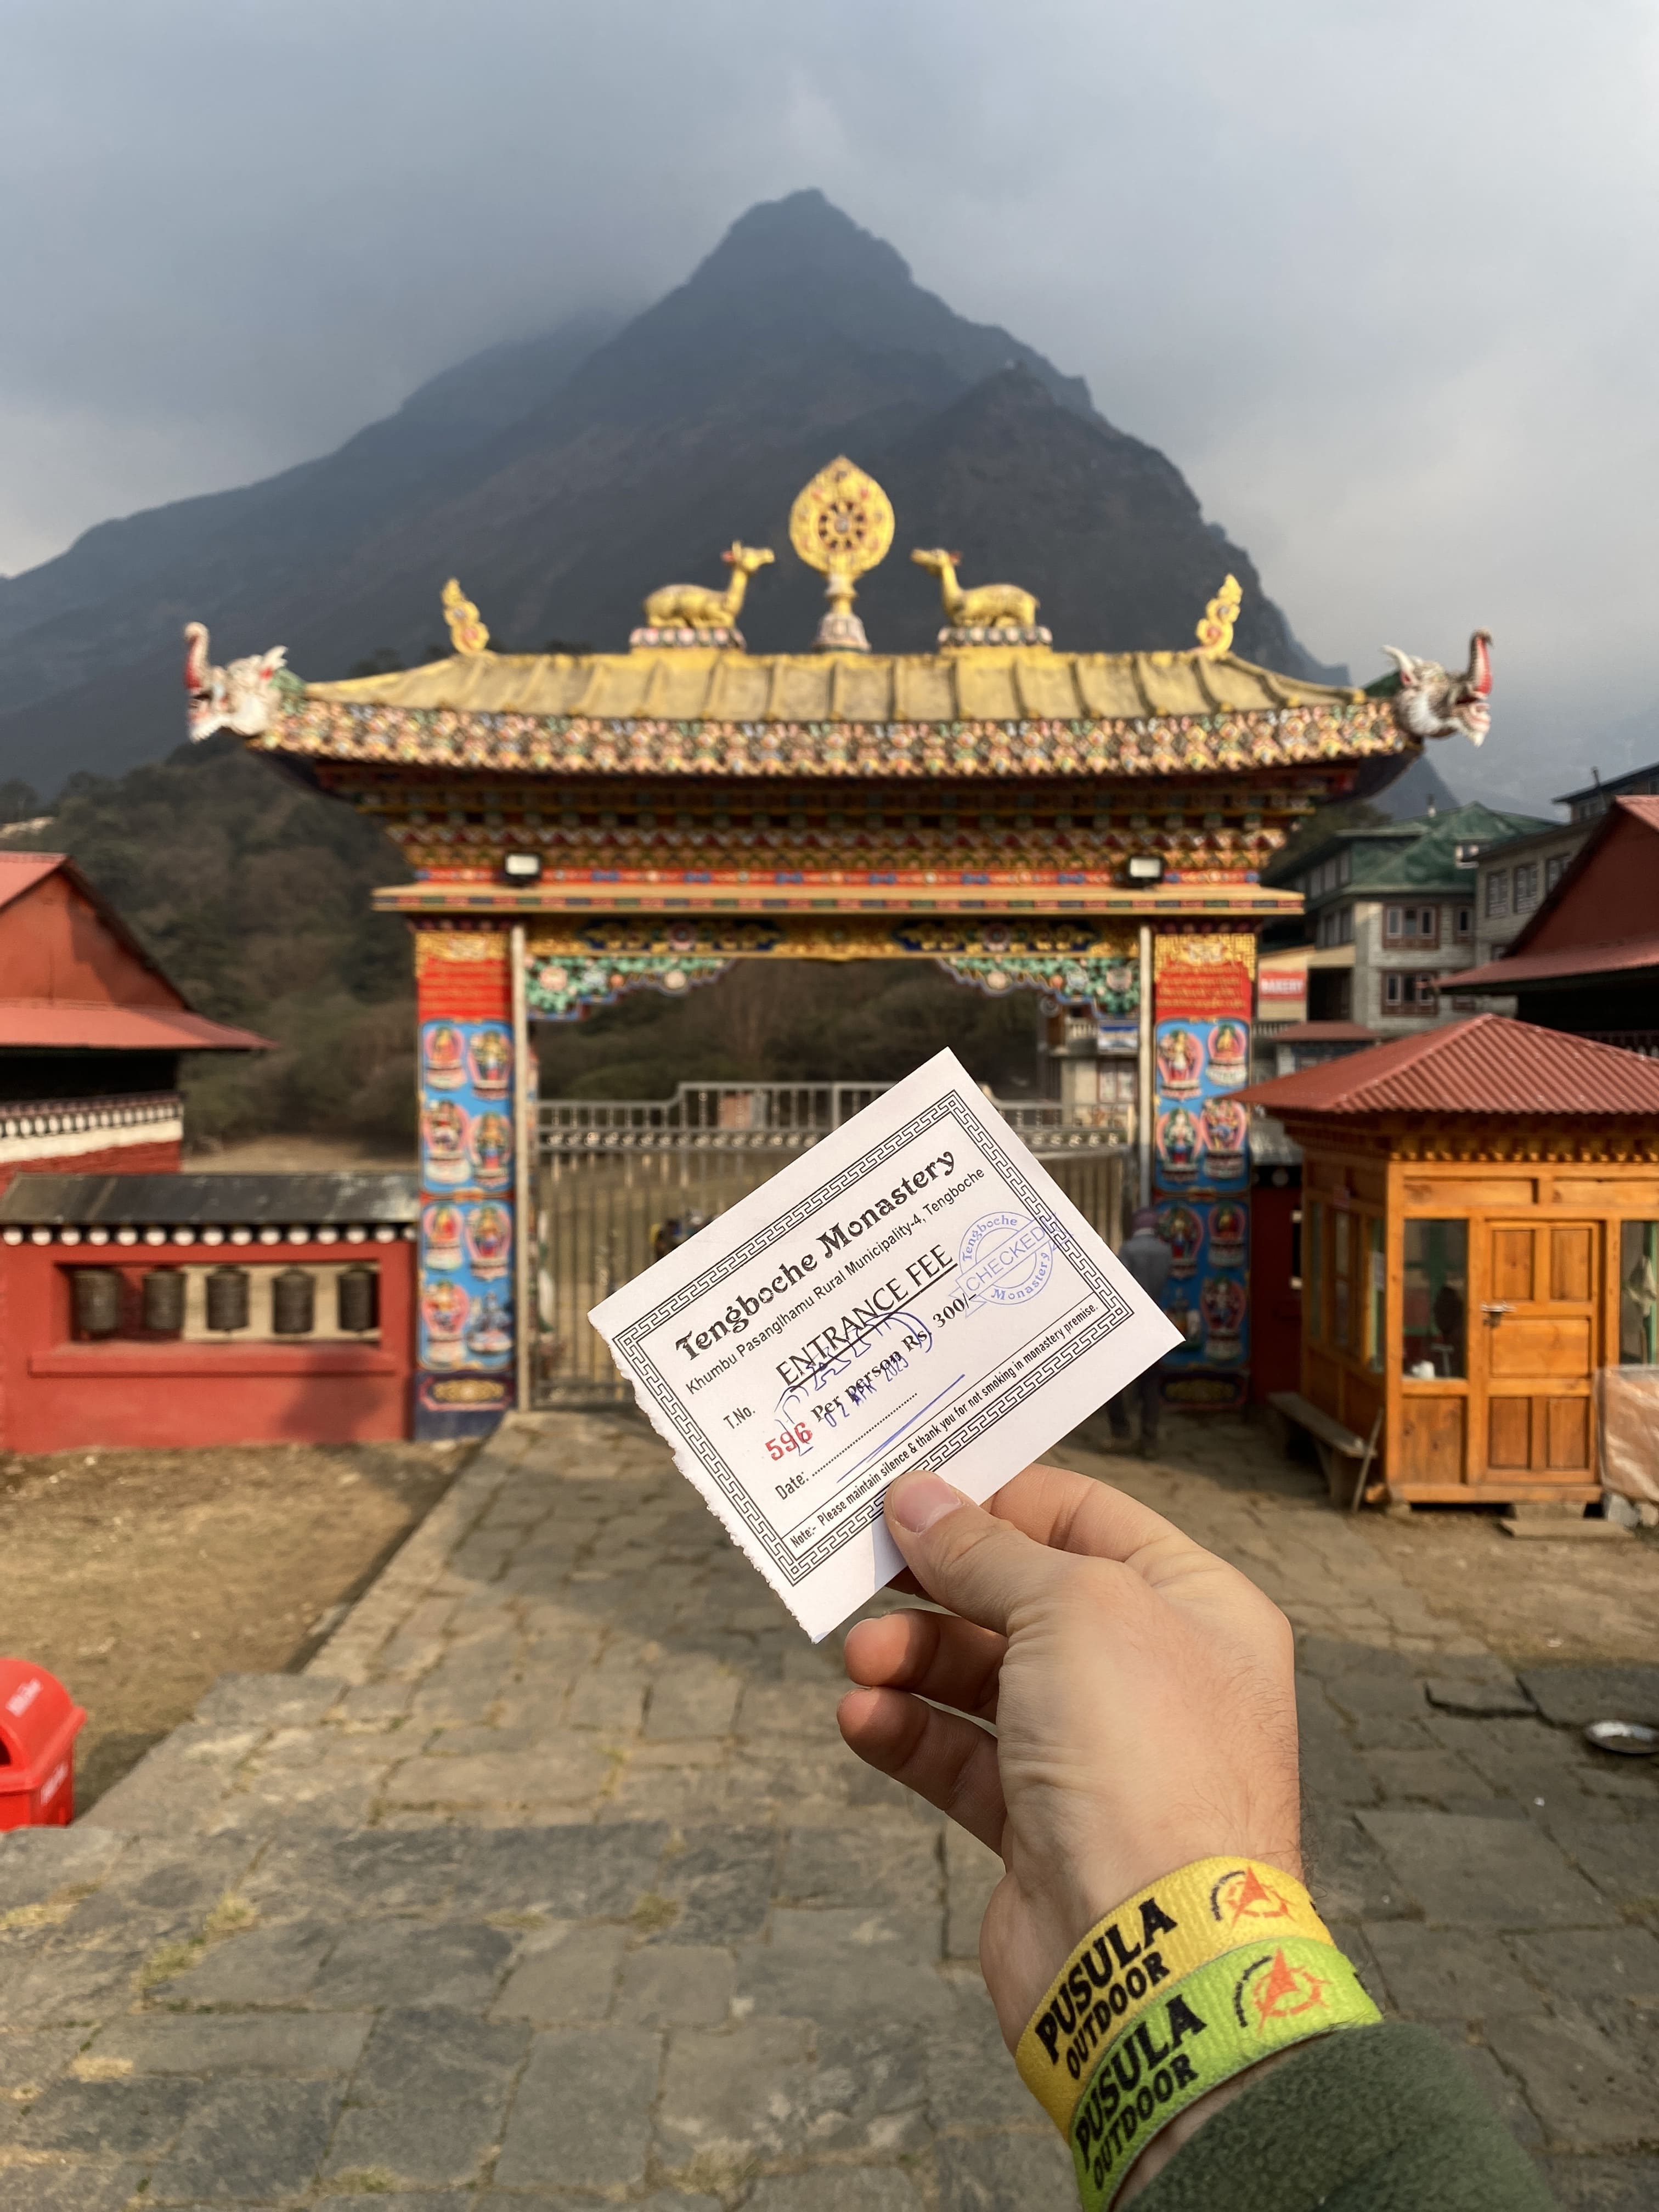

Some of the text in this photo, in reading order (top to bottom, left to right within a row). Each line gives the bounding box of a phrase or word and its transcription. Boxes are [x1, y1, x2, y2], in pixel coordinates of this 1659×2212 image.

[675, 1151, 955, 1361] Tengboche Monastery
[685, 1169, 985, 1395] Khumbu Pasanglhamu Rural Municipality-4, Tengboche
[962, 1215, 1018, 1261] Tengboche
[966, 1225, 1046, 1291] CHECKED
[991, 1252, 1048, 1301] Monastery
[775, 1244, 953, 1387] ENTRANCE FEE
[810, 1396, 842, 1422] Per
[844, 1351, 904, 1403] person
[933, 1293, 977, 1328] 300/-
[723, 1407, 755, 1430] T.No.
[765, 1423, 812, 1460] 596
[816, 1501, 847, 1526] Please
[845, 1473, 882, 1505] maintain
[880, 1451, 910, 1476] silence
[907, 1442, 918, 1454] &
[915, 1424, 942, 1447] thank
[939, 1413, 956, 1432] you
[953, 1403, 968, 1418] for
[967, 1391, 983, 1408] not
[981, 1367, 1017, 1396] smoking
[1012, 1361, 1025, 1371] in
[1023, 1328, 1065, 1364] monastery
[775, 1471, 809, 1500] Date:
[1035, 1897, 1178, 2066] PUSULA
[1066, 1950, 1171, 2081] OUTDOOR
[1075, 1994, 1207, 2174] PUSULA
[1093, 2053, 1199, 2191] OUTDOOR
